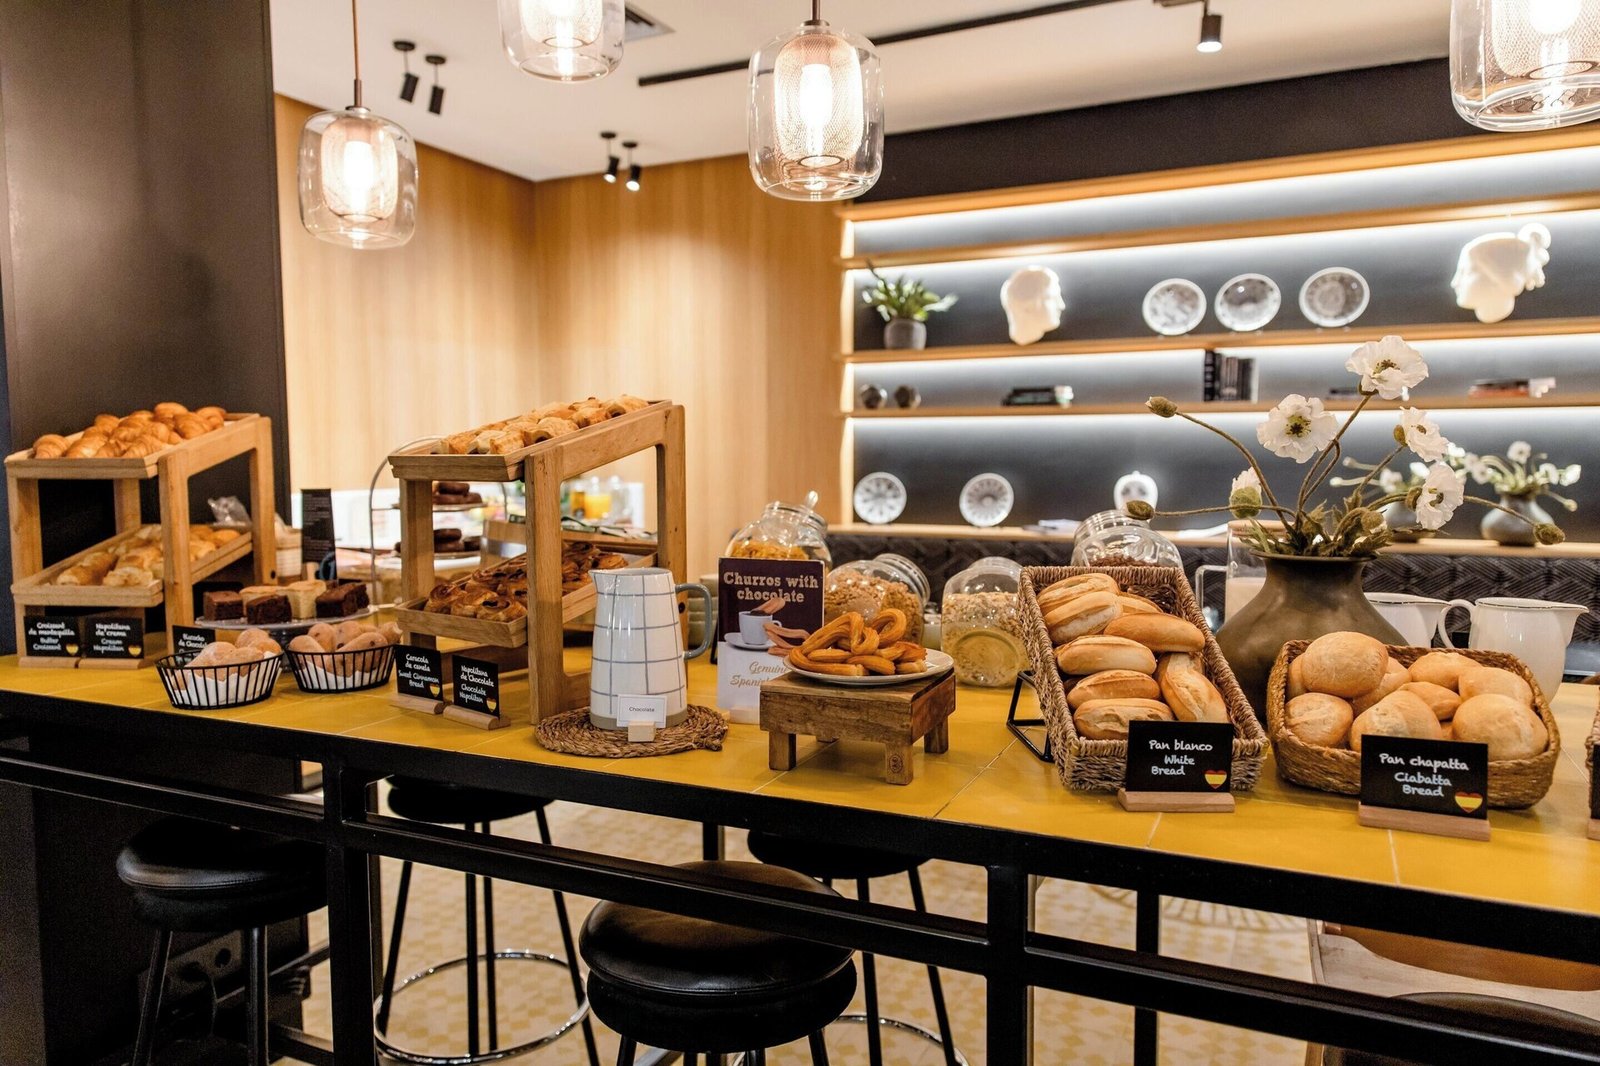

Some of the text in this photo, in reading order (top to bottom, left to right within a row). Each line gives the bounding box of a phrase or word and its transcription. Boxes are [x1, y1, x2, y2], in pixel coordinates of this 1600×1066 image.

[723, 571, 819, 589] Churros with
[736, 588, 805, 603] chocolate
[405, 653, 429, 664] Caracola
[404, 661, 431, 672] de canela
[460, 665, 489, 678] Napolitana
[748, 661, 788, 674] Genuin
[408, 679, 425, 688] Bread
[412, 672, 439, 684] Cinnamon
[460, 672, 495, 687] de Chocolate
[460, 684, 487, 697] Chocolate
[459, 691, 484, 704] Napolitan
[1148, 739, 1213, 751] Pan blanco
[1164, 754, 1195, 765] White
[1379, 753, 1470, 773] Pan chapatta
[1151, 765, 1186, 776] Bread
[1393, 771, 1452, 787] Ciabatta
[1402, 784, 1445, 798] Bread
